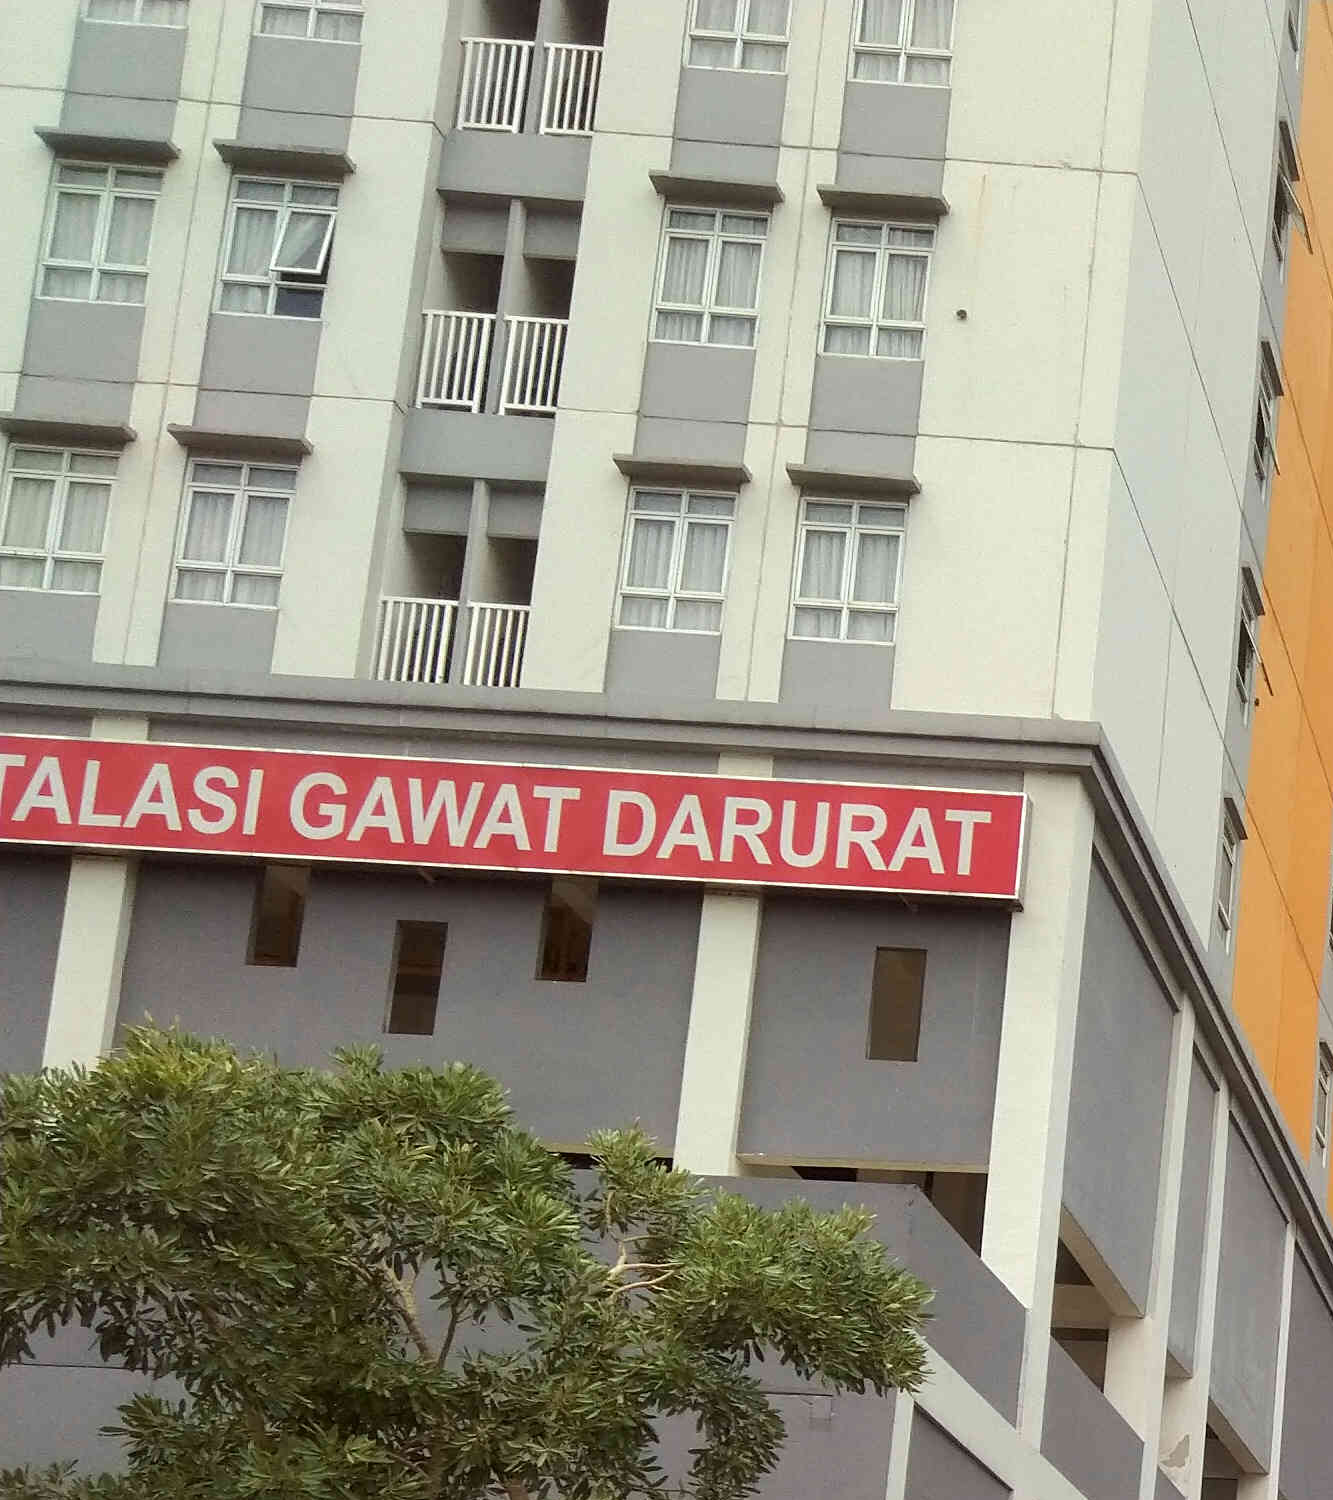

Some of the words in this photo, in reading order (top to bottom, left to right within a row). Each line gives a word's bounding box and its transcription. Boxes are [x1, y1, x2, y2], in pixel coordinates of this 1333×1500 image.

[0, 753, 264, 837] TALASI
[289, 771, 582, 853] GAWAT
[602, 794, 992, 876] DARURAT
